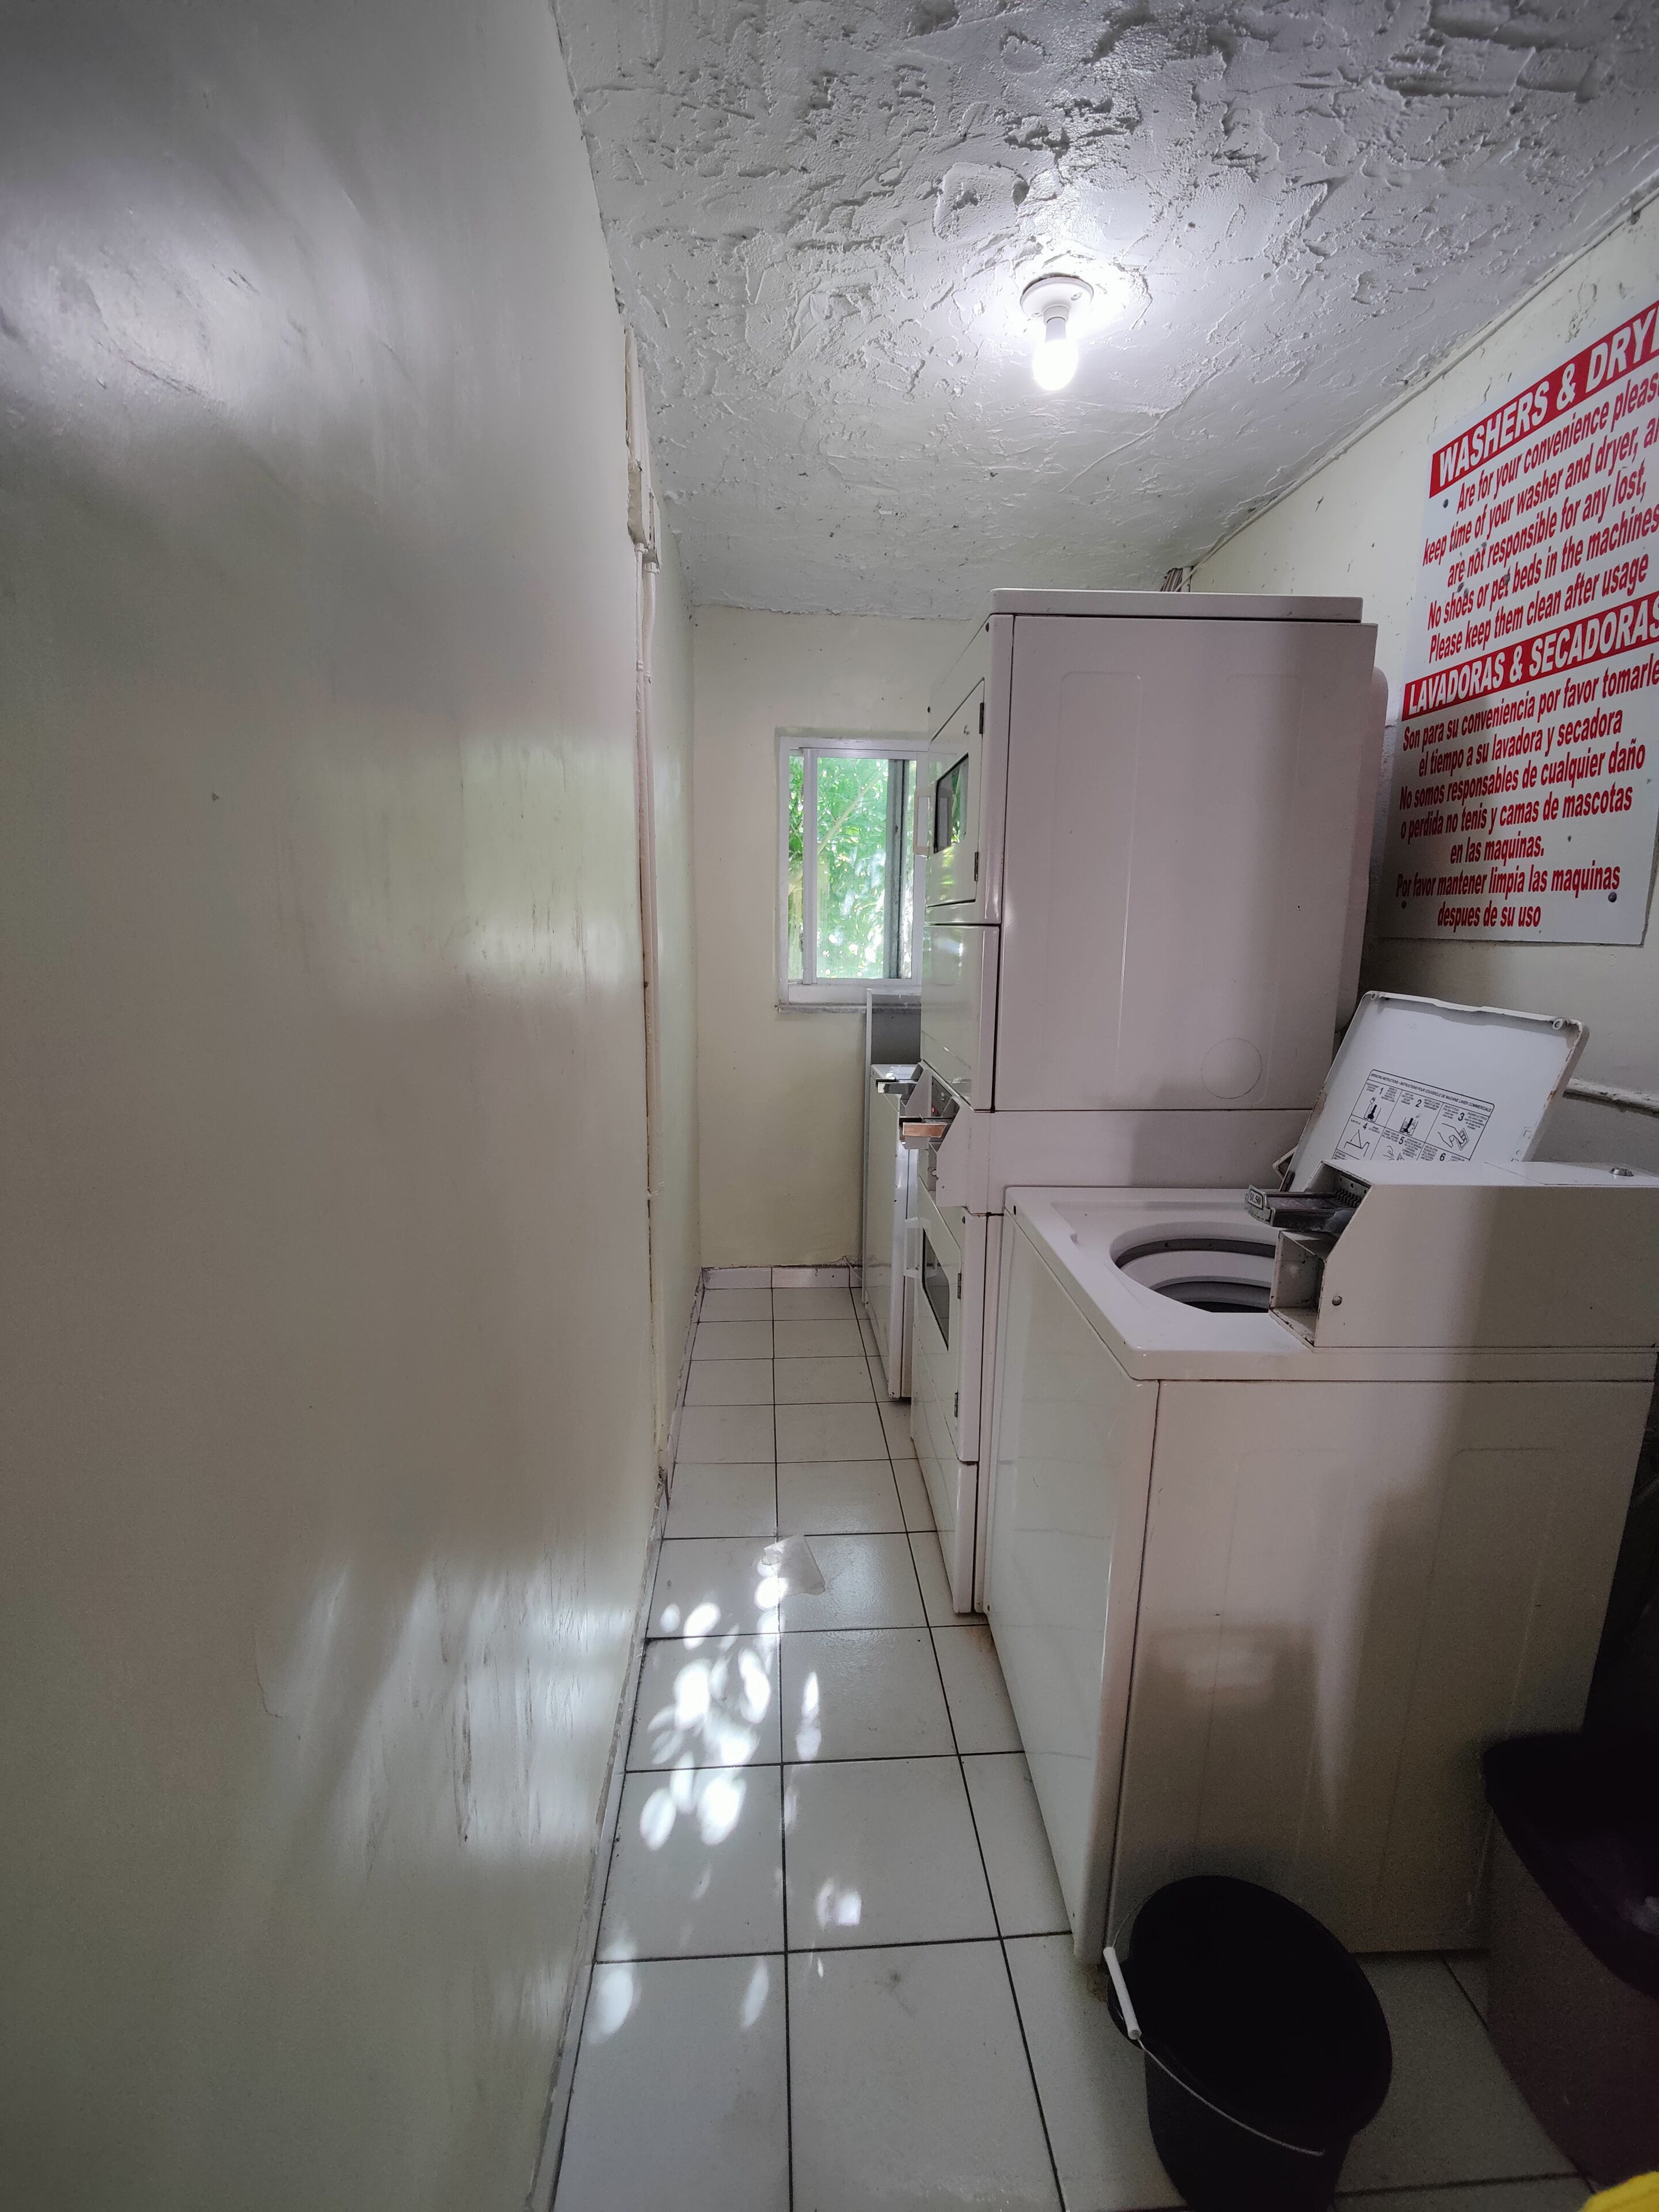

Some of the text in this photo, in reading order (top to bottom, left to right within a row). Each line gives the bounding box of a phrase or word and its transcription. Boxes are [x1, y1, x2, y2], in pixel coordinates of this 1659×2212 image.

[1440, 381, 1549, 488] WASHERS
[1556, 363, 1577, 411] &
[1457, 372, 1659, 514] Are for your convenience pleas
[1422, 538, 1447, 566] keep
[1449, 521, 1472, 552] time
[1475, 503, 1488, 539] of
[1487, 495, 1515, 540] your
[1517, 468, 1564, 516] washer
[1565, 442, 1594, 490] and
[1595, 426, 1639, 476] dryer,
[1447, 457, 1646, 588] are not responsible for any lost,
[1427, 503, 1659, 631] No shoes or pet beds in the machines
[1429, 554, 1649, 664] Please keep them clean after usage
[1403, 653, 1659, 753] Son para su conveniencia por favor tomarle
[1408, 652, 1505, 715] LAVADORAS
[1509, 645, 1523, 683] &
[1399, 737, 1646, 810] No somos responsables de cualquier daño
[1419, 707, 1623, 777] el tiempo a su lavadora y secadora
[1401, 782, 1633, 844] o perdida no tenis y camas de mascotas
[1396, 860, 1620, 900] Por favor mantener limpia las maquinas
[1450, 831, 1544, 866] en las maquinas.
[1437, 900, 1541, 933] despues de su uso
[1415, 1099, 1422, 1108] 2
[1458, 1112, 1465, 1122] 3
[1399, 1137, 1405, 1145] 5
[1440, 1153, 1446, 1161] 6
[1249, 1192, 1261, 1205] $1.50
